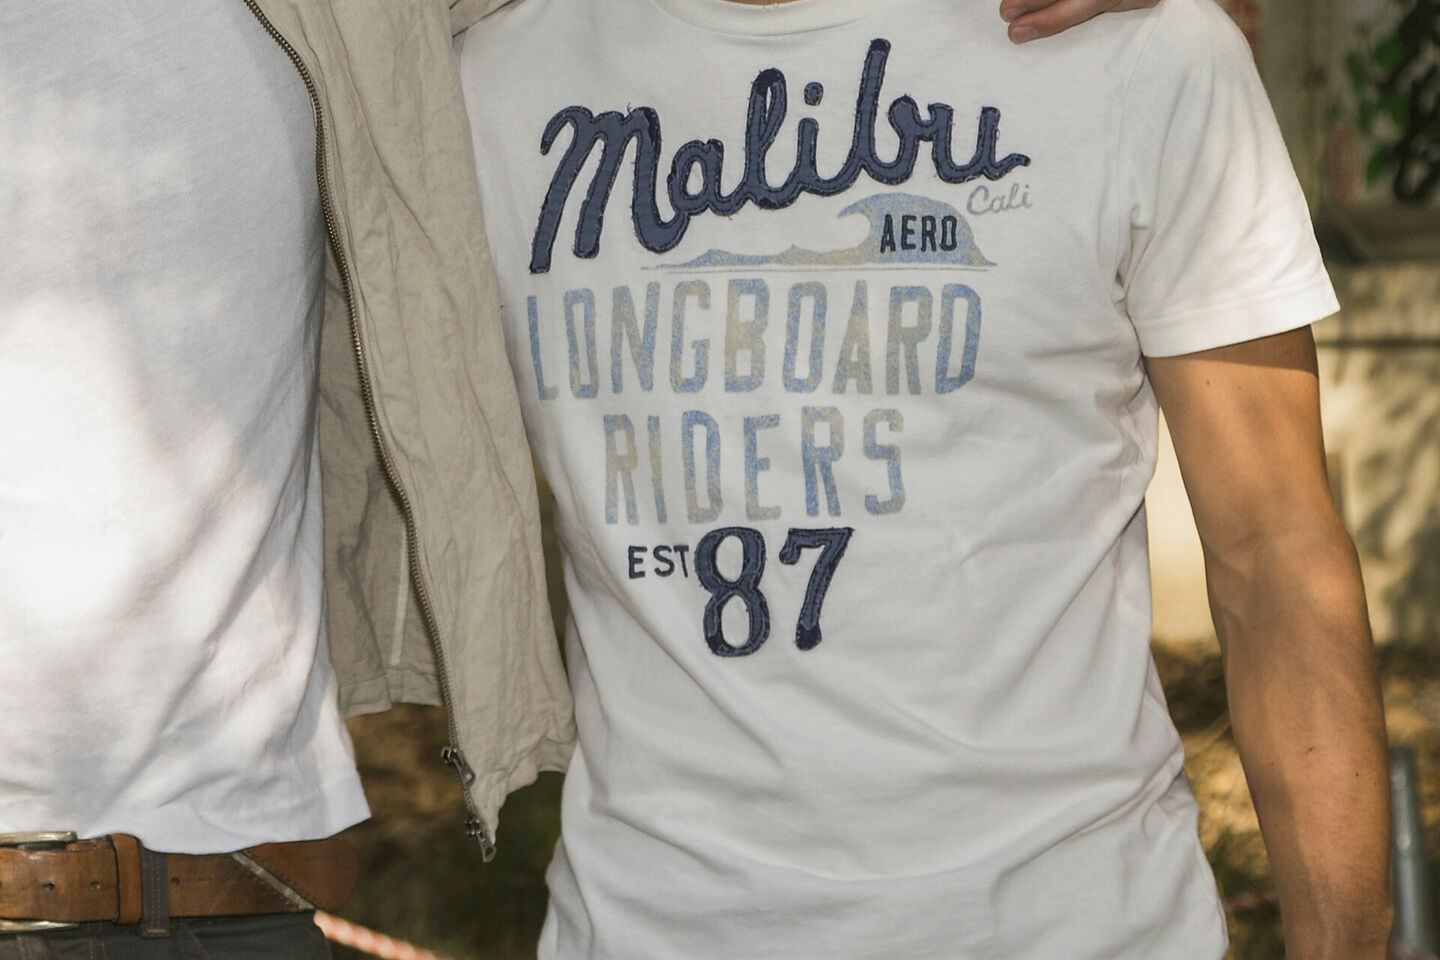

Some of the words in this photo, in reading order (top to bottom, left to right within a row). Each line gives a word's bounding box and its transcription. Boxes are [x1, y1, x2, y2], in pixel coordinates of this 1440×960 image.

[528, 38, 1031, 274] Malibu
[966, 183, 1033, 217] Cali
[879, 214, 958, 255] AERO
[526, 278, 982, 401] LONGBOARD
[603, 405, 907, 526] RIDERS
[627, 544, 691, 580] EST
[693, 526, 856, 658] 87
